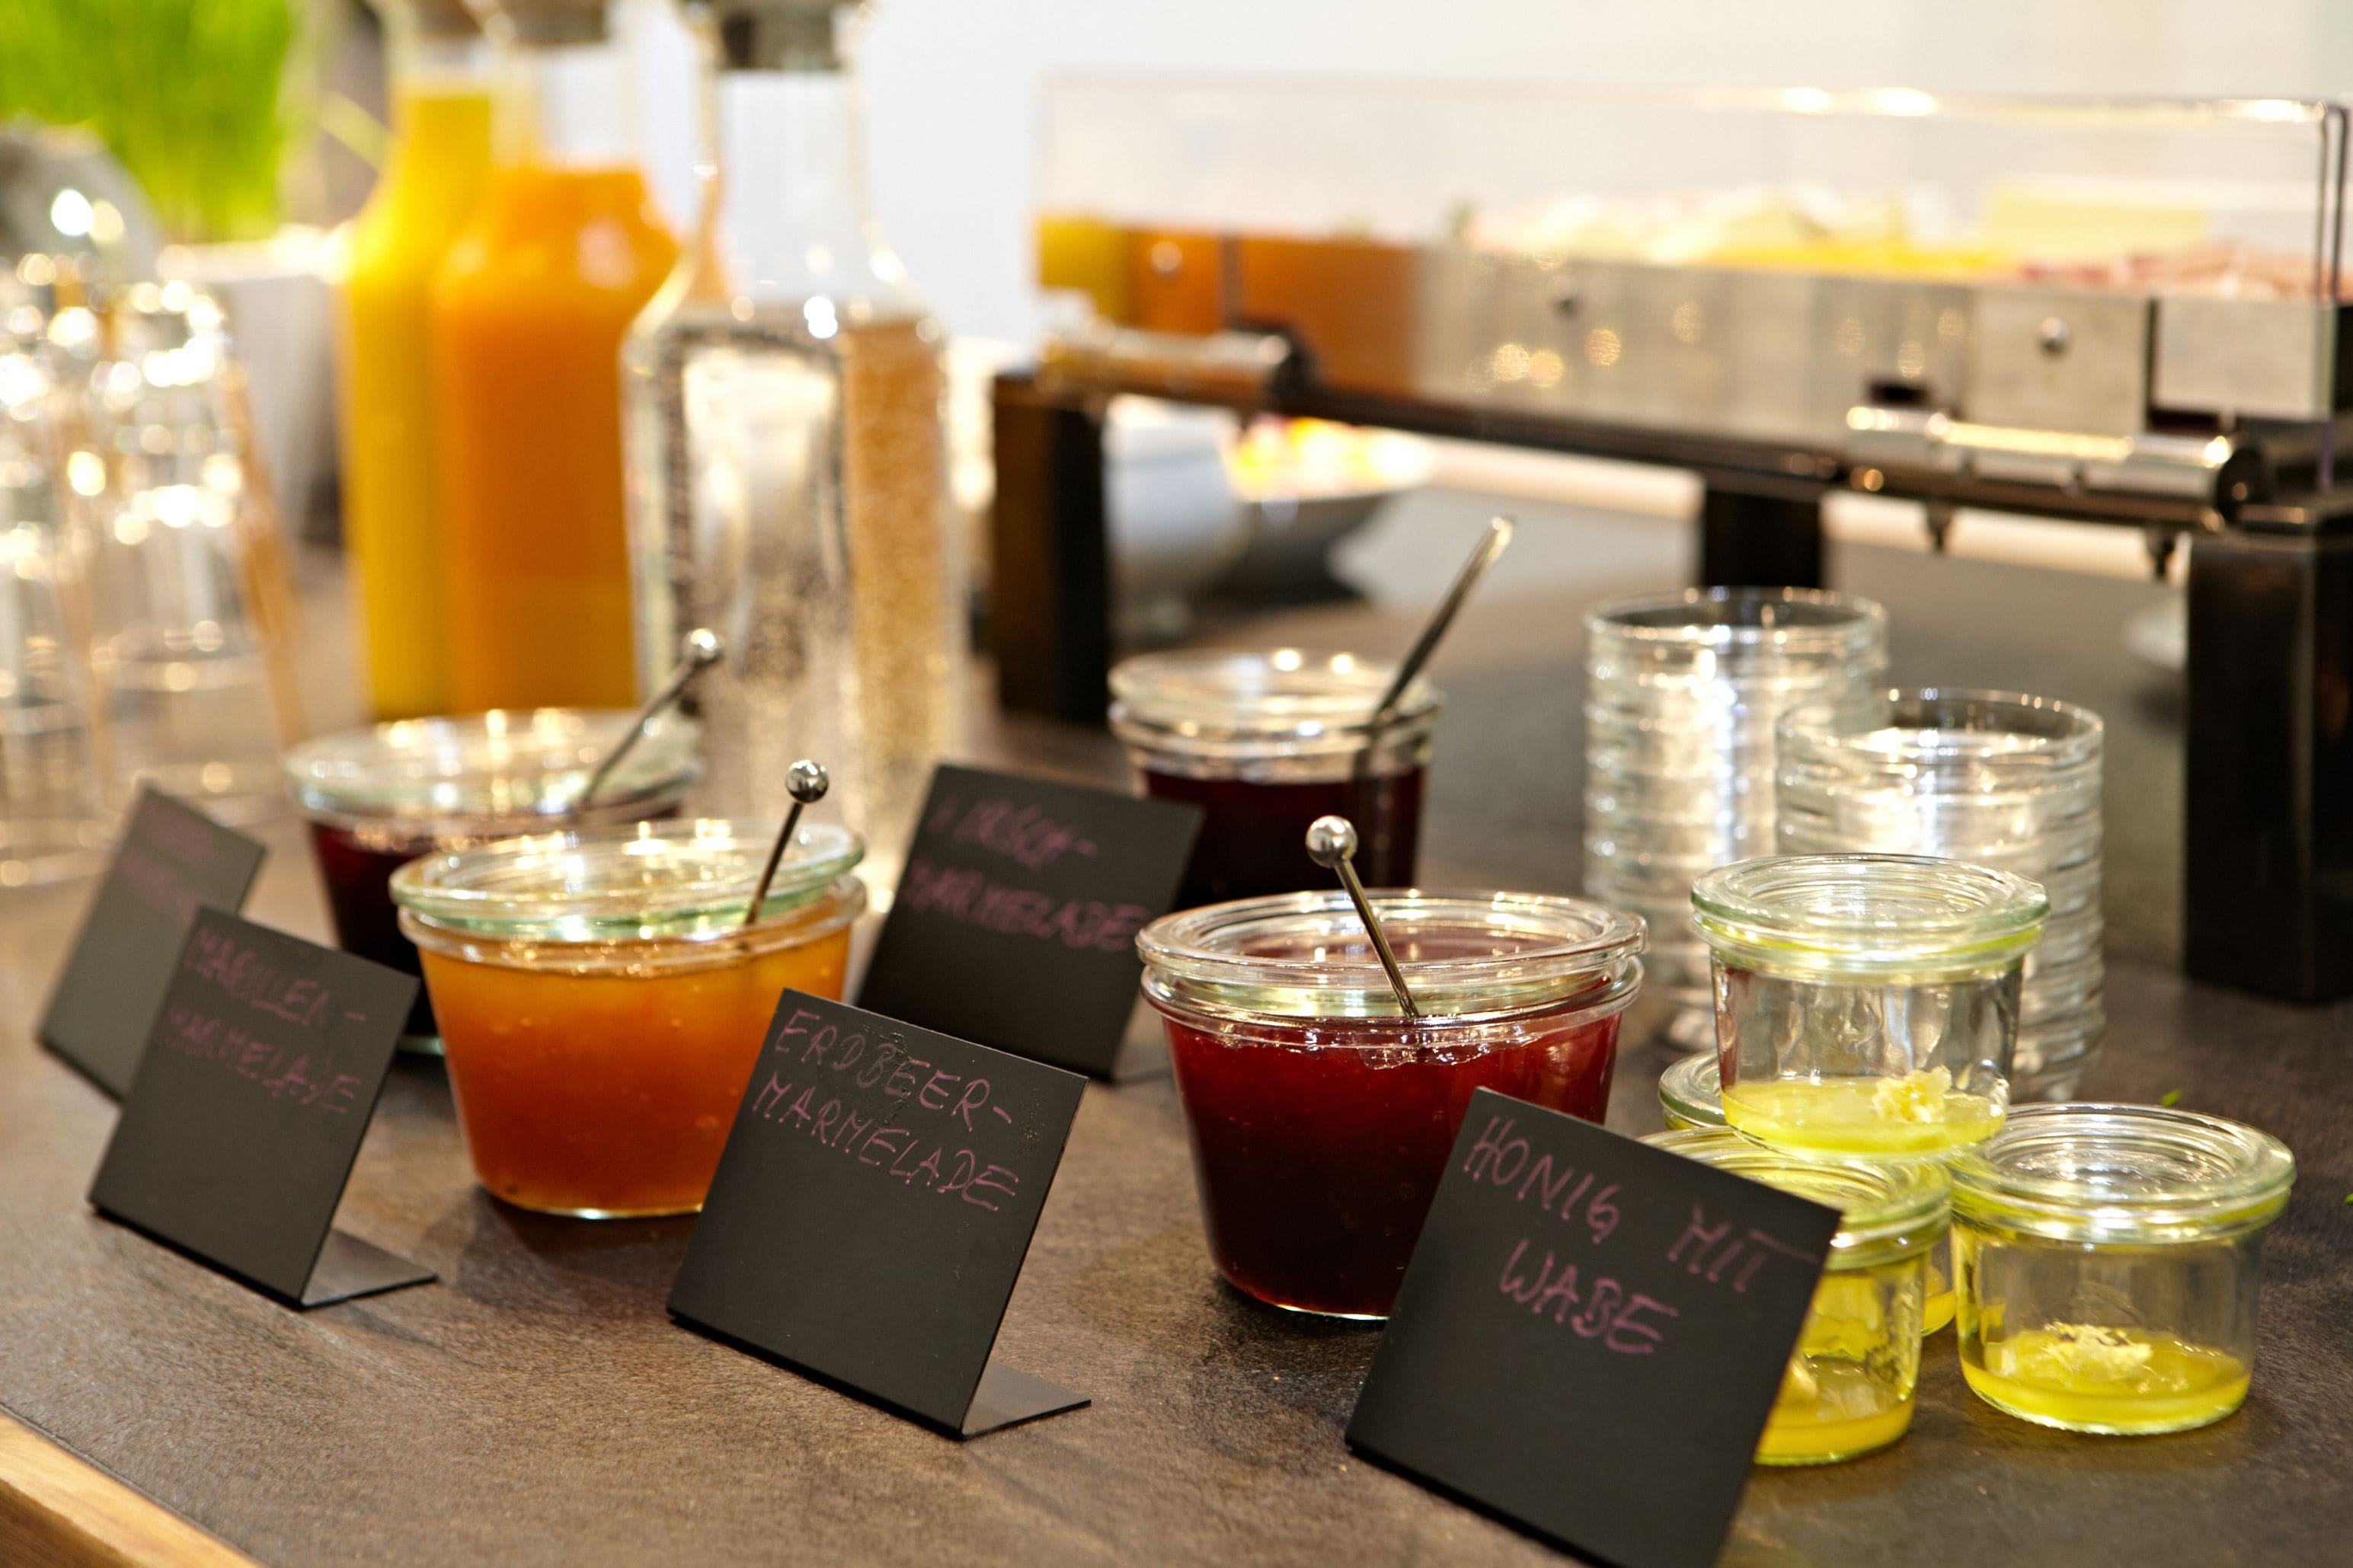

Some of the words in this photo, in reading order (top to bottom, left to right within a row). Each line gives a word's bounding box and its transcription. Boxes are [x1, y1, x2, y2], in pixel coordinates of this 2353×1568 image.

[775, 1008, 1012, 1132] ERDBEER-
[753, 1070, 1019, 1212] MARMELADE
[1463, 1116, 1622, 1244] HONIG
[1667, 1204, 1821, 1293] MIT
[1499, 1237, 1680, 1355] WABE
